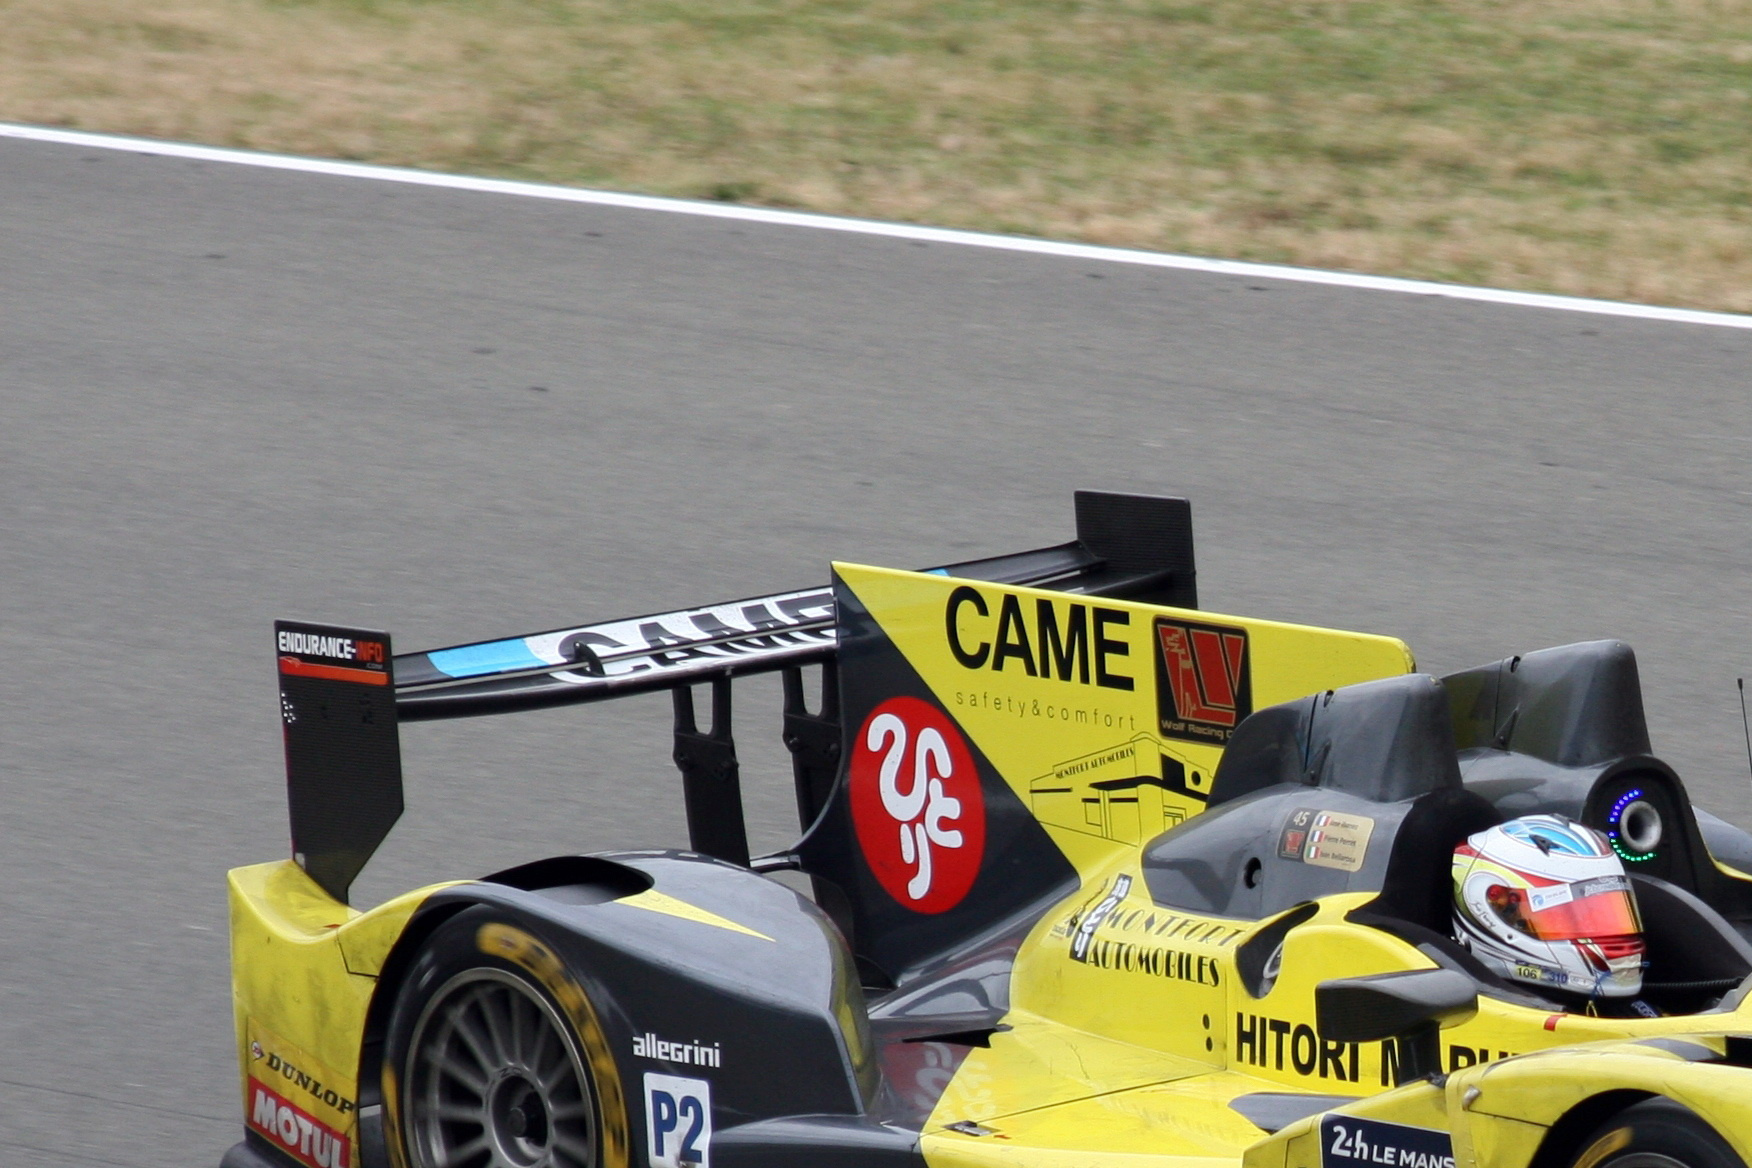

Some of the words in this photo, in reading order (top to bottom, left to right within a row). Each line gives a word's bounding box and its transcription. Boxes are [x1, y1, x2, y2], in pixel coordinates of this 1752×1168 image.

[945, 586, 1135, 692] CAME
[1161, 719, 1185, 731] Wolf
[1188, 723, 1224, 740] Racing
[1292, 811, 1311, 827] 45
[1087, 939, 1219, 988] AUTOMOBILES
[266, 1052, 356, 1114] DUNLOP
[651, 1089, 704, 1163] P2
[1372, 1145, 1396, 1165] LE
